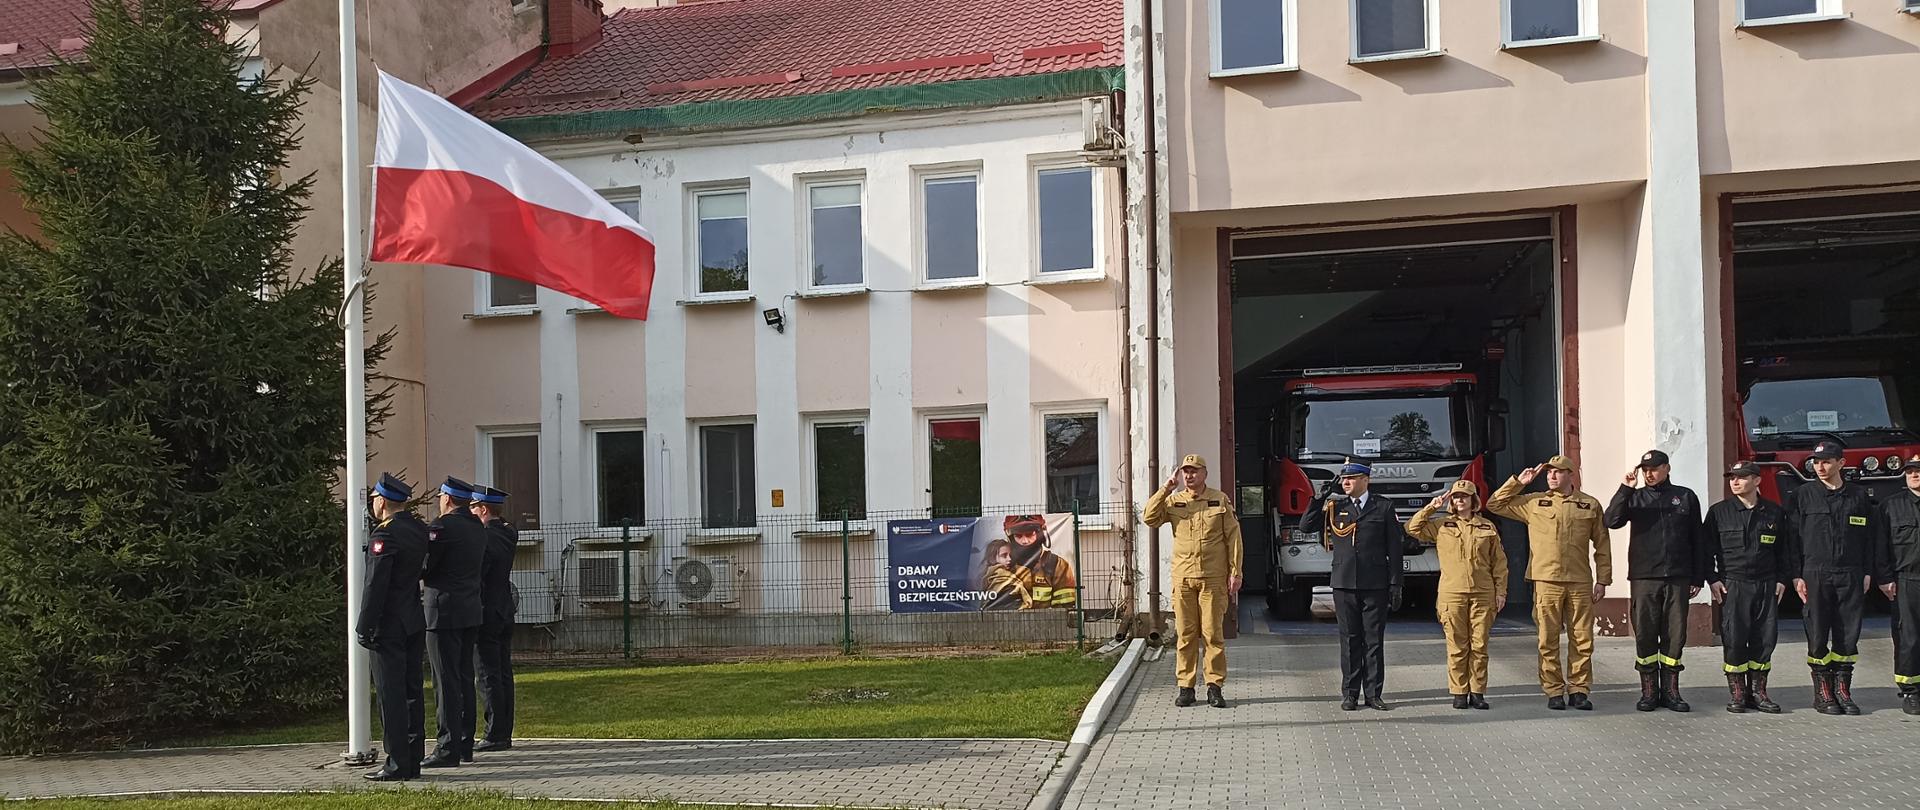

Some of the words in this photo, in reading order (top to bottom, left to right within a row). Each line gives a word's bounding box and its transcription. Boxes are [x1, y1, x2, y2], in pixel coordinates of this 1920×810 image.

[898, 565, 939, 576] DBAMY
[898, 580, 907, 589] O
[910, 578, 947, 589] TWOJE
[899, 590, 998, 603] BEZPIECZEŃSTWO
